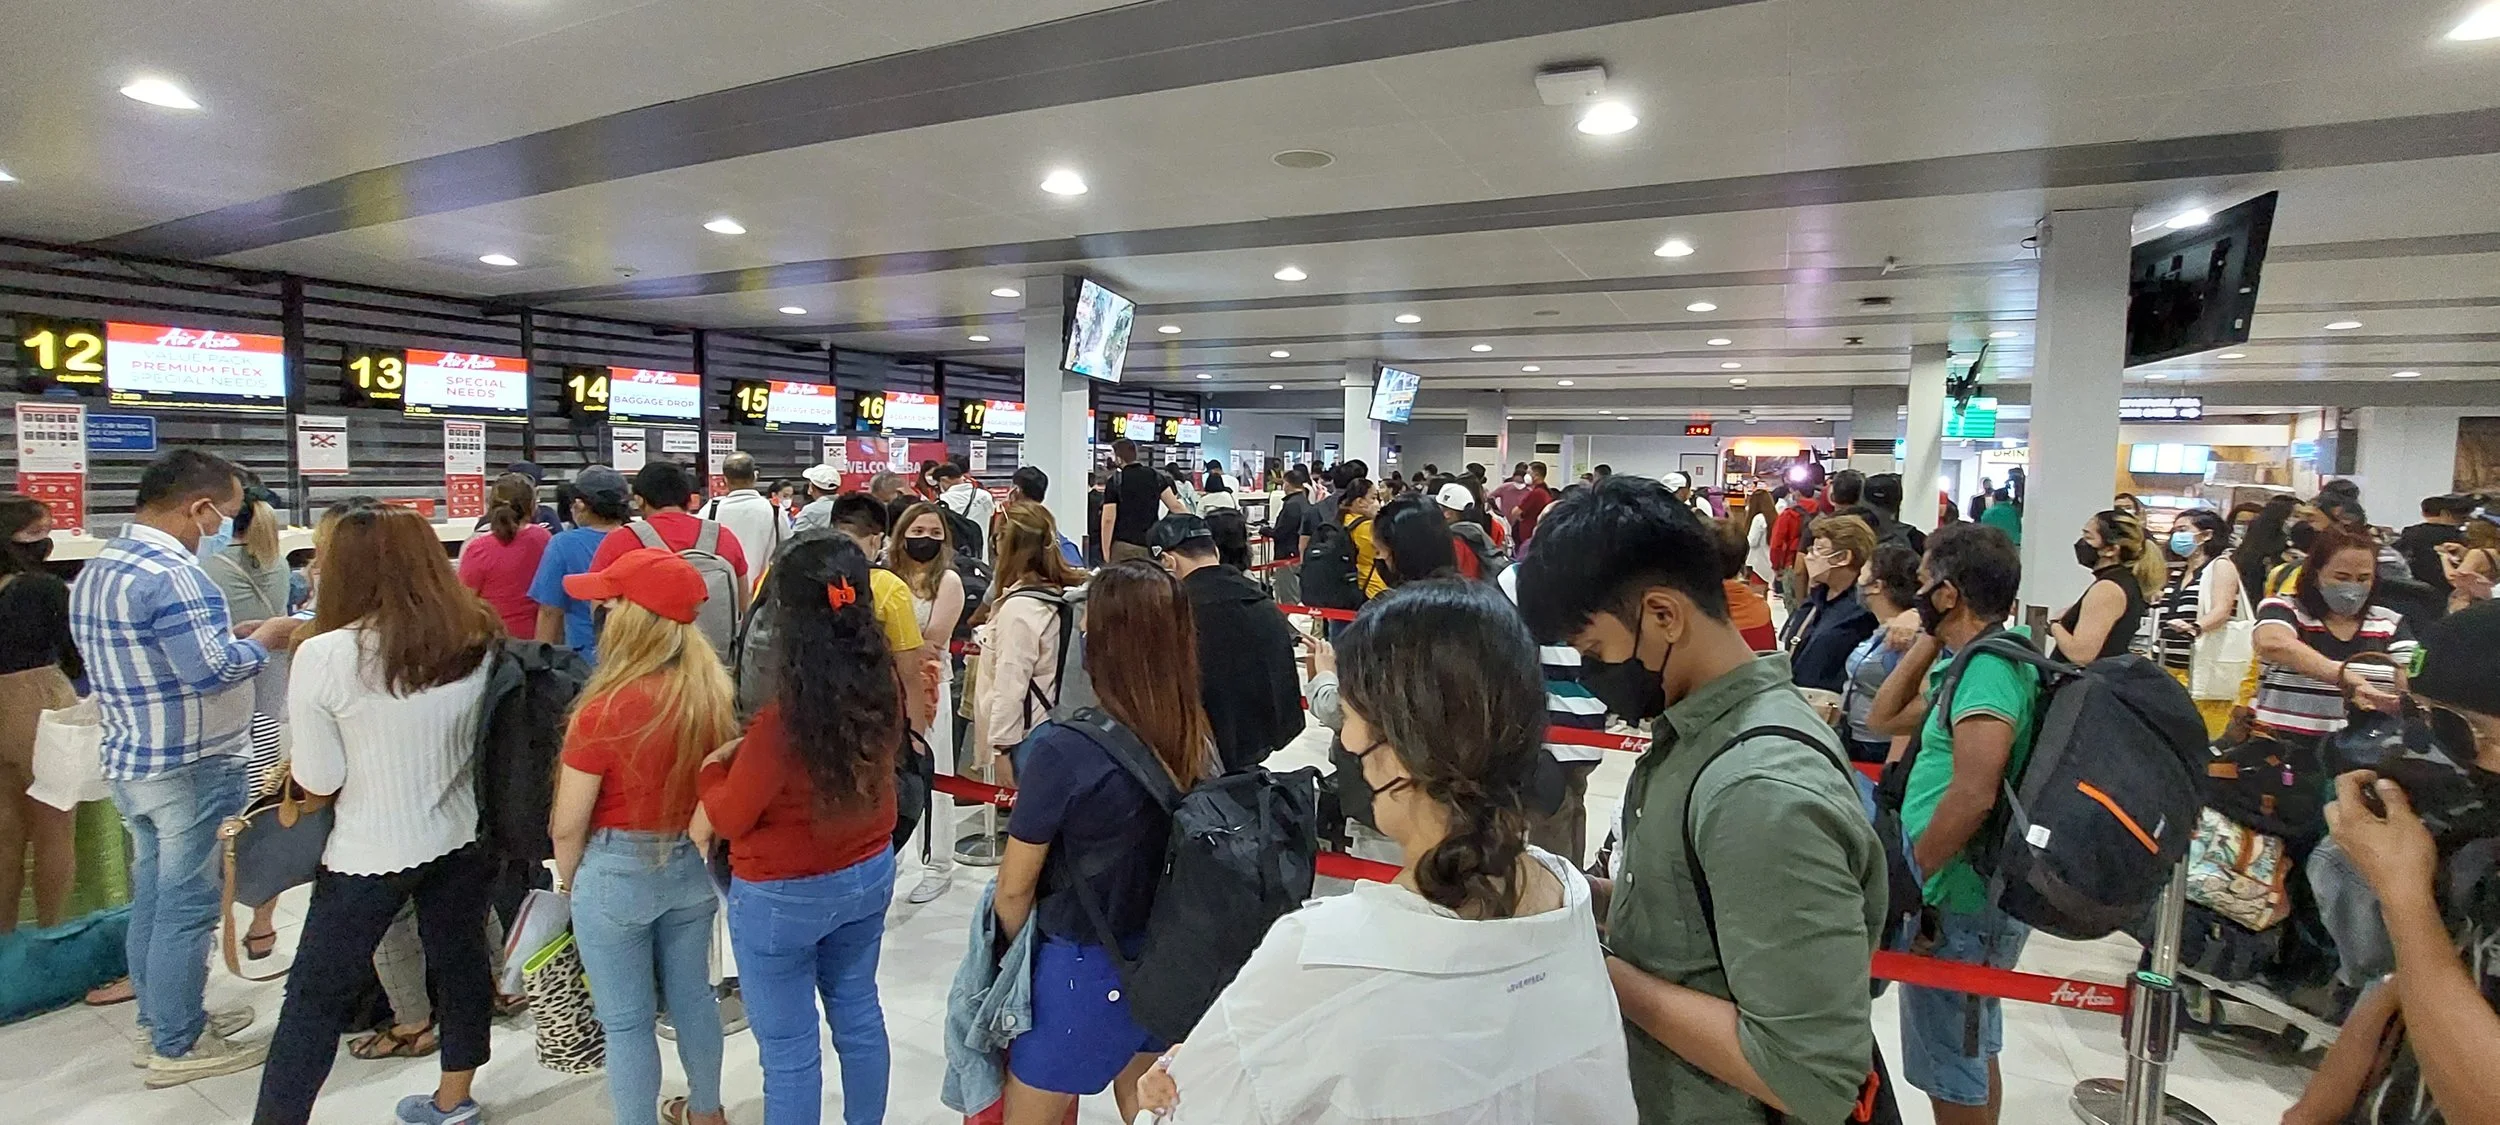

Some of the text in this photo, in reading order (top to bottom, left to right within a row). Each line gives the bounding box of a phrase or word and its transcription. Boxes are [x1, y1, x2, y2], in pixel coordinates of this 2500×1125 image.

[24, 331, 103, 371] 12
[144, 350, 253, 366] VALUE PACK
[132, 361, 263, 377] PREMIUM FLEX
[350, 356, 403, 389] 13
[131, 371, 268, 388] SPECIAL NEEDS
[446, 376, 506, 389] SPECIAL
[446, 387, 496, 398] NEEDS
[569, 375, 609, 403] 14
[614, 396, 694, 408] BAGGAGE DROP
[737, 387, 769, 411] 15
[860, 397, 884, 419] 16
[964, 404, 985, 424] 17
[1113, 416, 1126, 433] 19
[1165, 420, 1178, 435] 20
